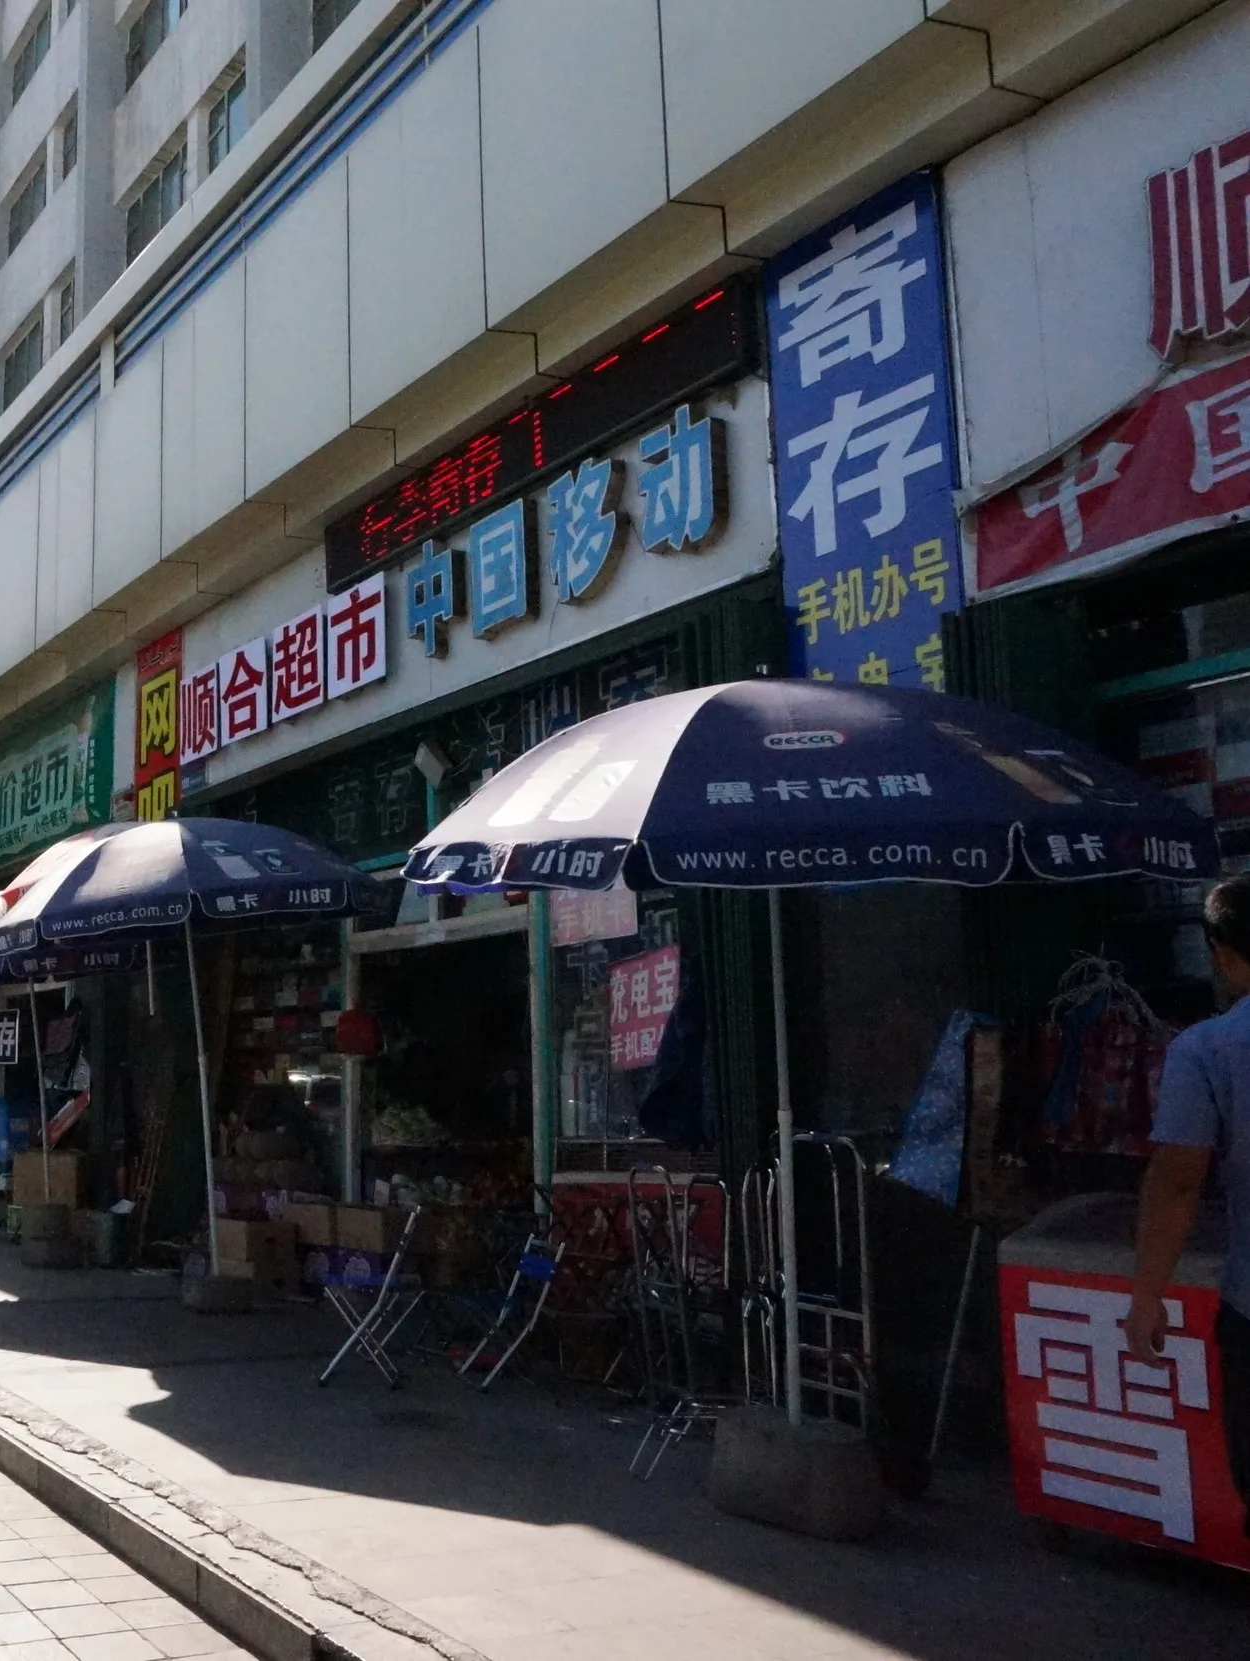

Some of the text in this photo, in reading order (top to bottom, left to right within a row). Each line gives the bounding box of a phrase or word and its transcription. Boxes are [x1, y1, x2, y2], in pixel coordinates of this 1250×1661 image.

[776, 199, 943, 558] 寄存
[407, 403, 716, 657] 中国移动
[796, 538, 950, 645] 手机办号
[181, 587, 386, 757] 顺合超市
[138, 668, 177, 822] 网吧
[769, 733, 837, 748] RECCA
[705, 772, 934, 805] 黑卡饮料
[427, 848, 605, 878] 黑卡 小时
[1046, 832, 1197, 869] 黑卡 小时
[215, 887, 332, 912] 黑卡 小时
[609, 956, 678, 1027] 充电宝
[609, 1024, 666, 1064] 手机配
[1014, 1281, 1210, 1543] 雪
